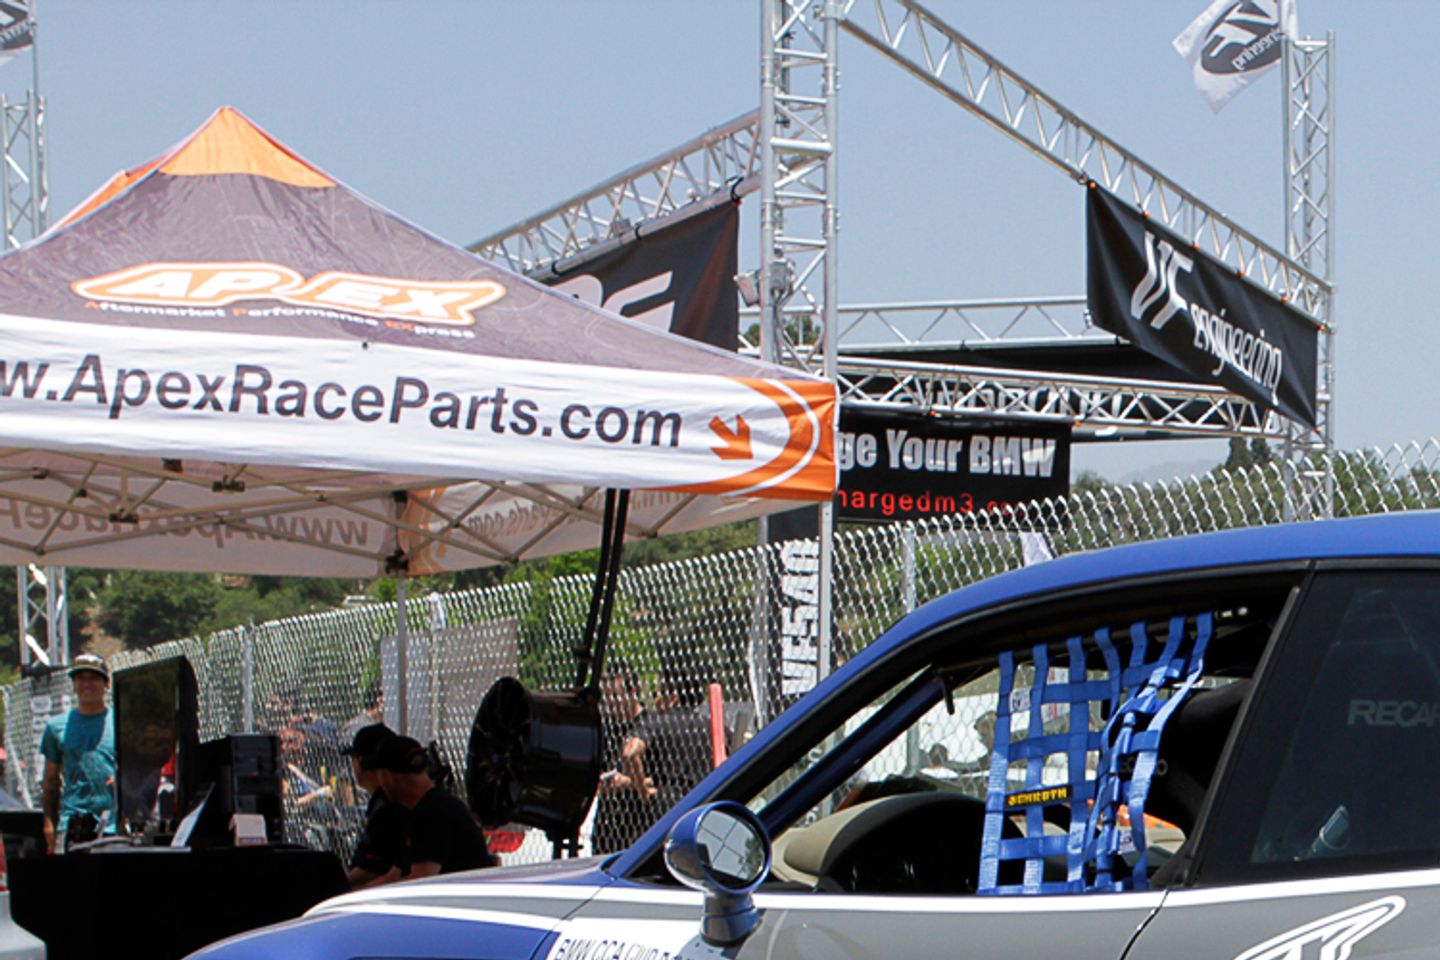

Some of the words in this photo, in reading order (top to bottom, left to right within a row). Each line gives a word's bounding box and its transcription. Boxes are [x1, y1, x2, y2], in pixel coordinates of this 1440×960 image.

[112, 268, 476, 321] APEX
[885, 428, 963, 472] Your
[969, 434, 1057, 478] BMW
